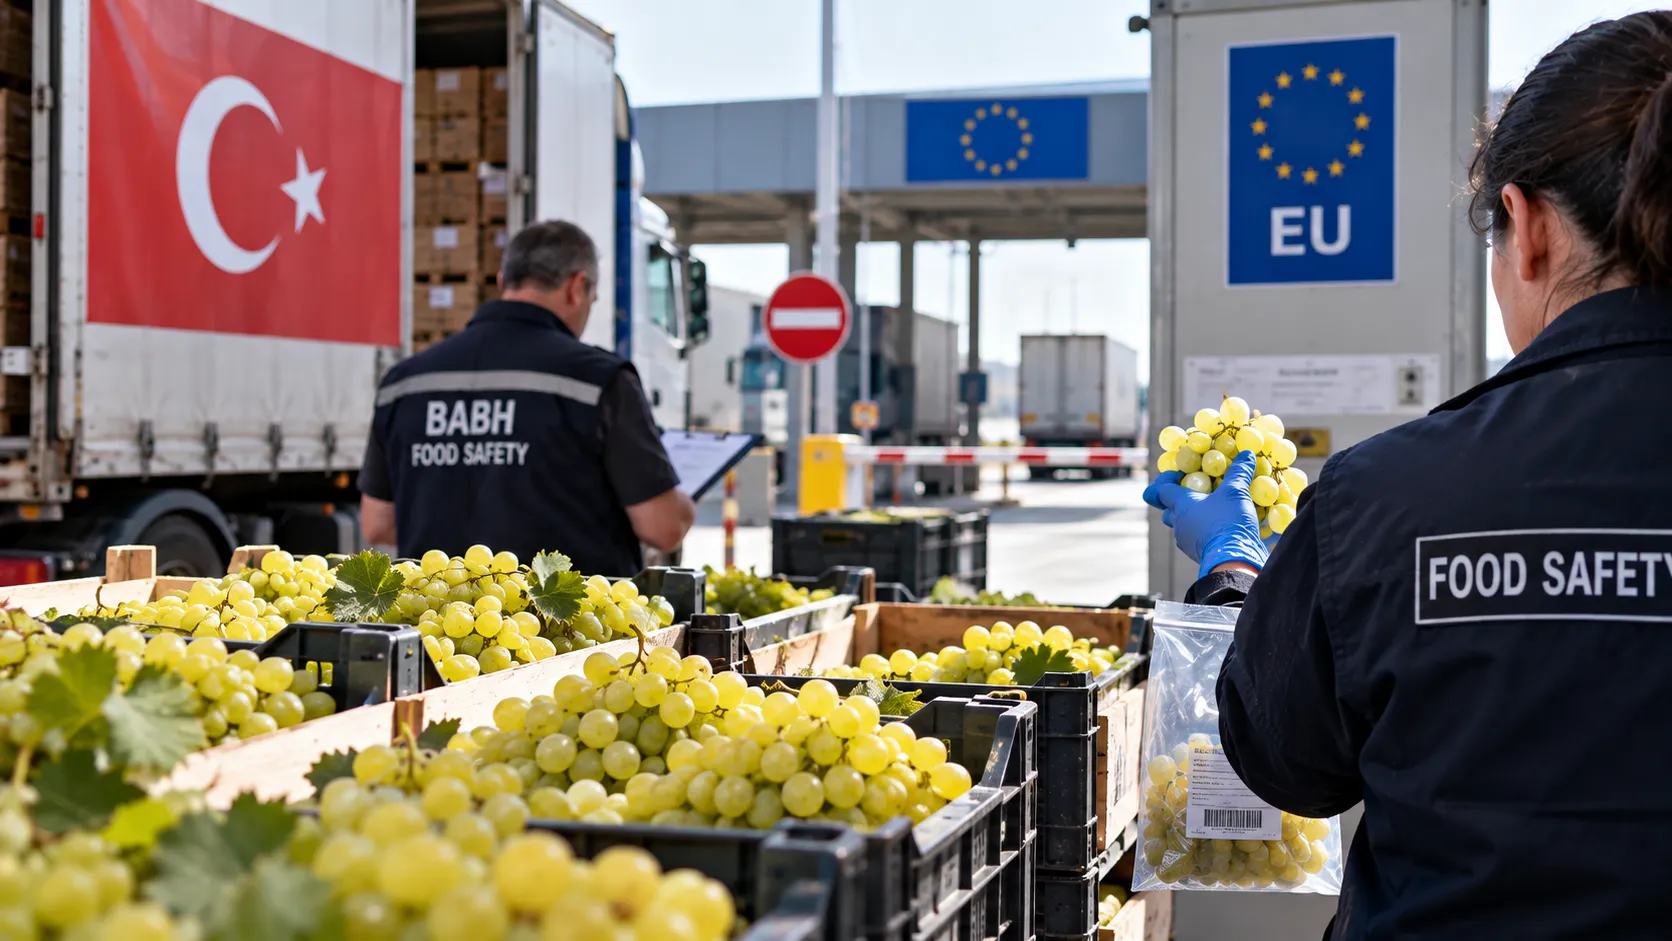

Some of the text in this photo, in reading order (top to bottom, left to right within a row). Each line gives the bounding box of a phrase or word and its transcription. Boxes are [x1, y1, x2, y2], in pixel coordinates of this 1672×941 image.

[1271, 205, 1351, 256] EU
[426, 399, 516, 436] BABH
[411, 441, 530, 467] FOOD SAFETY
[1429, 552, 1527, 600] FOOD
